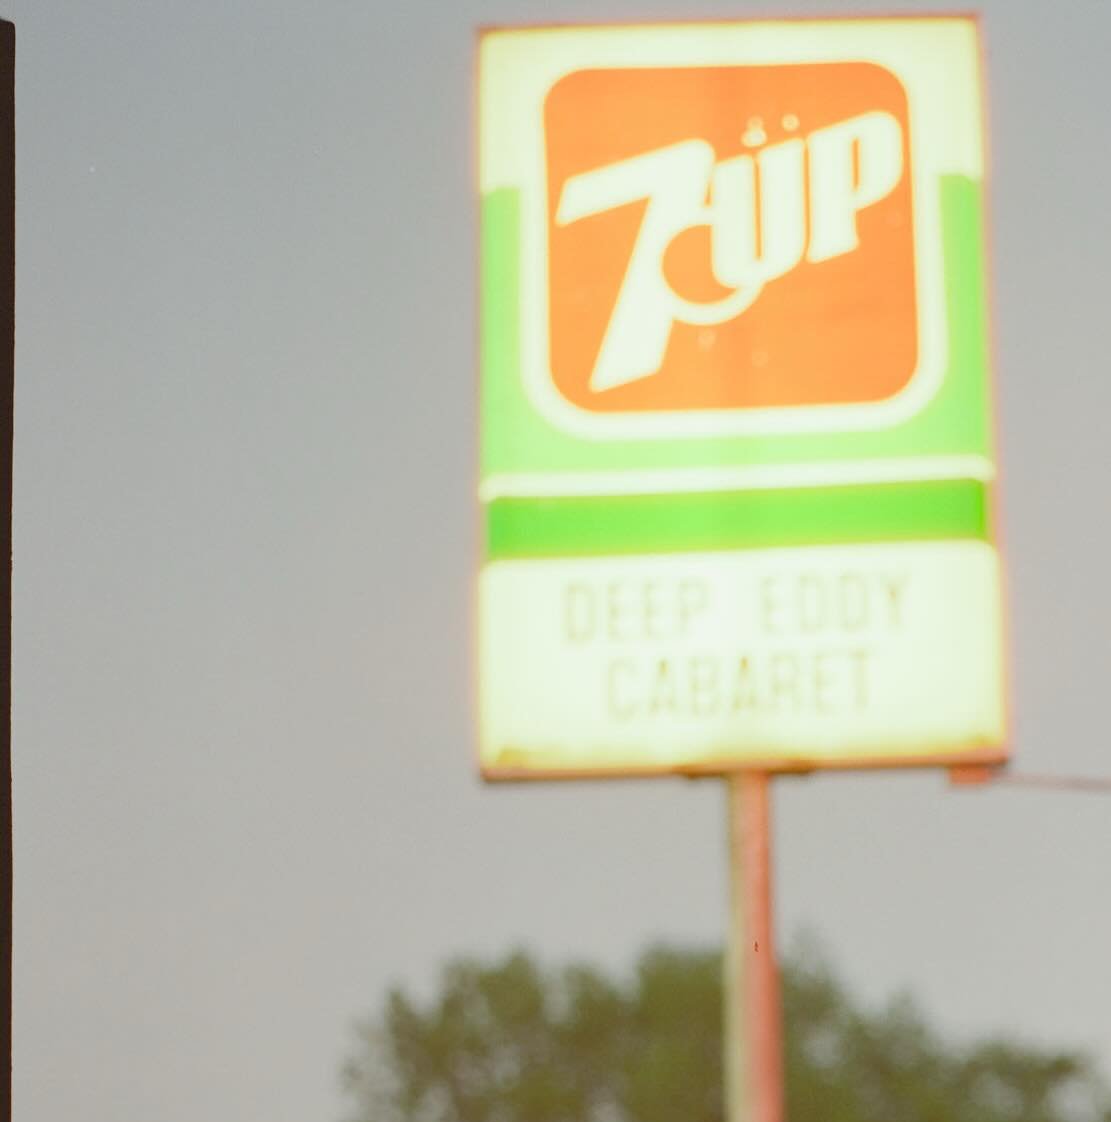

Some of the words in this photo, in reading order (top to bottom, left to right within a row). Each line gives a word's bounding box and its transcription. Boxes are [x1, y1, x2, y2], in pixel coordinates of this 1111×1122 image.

[562, 576, 711, 645] DEEP
[760, 570, 913, 635] EDDY
[606, 646, 878, 720] CABARET
